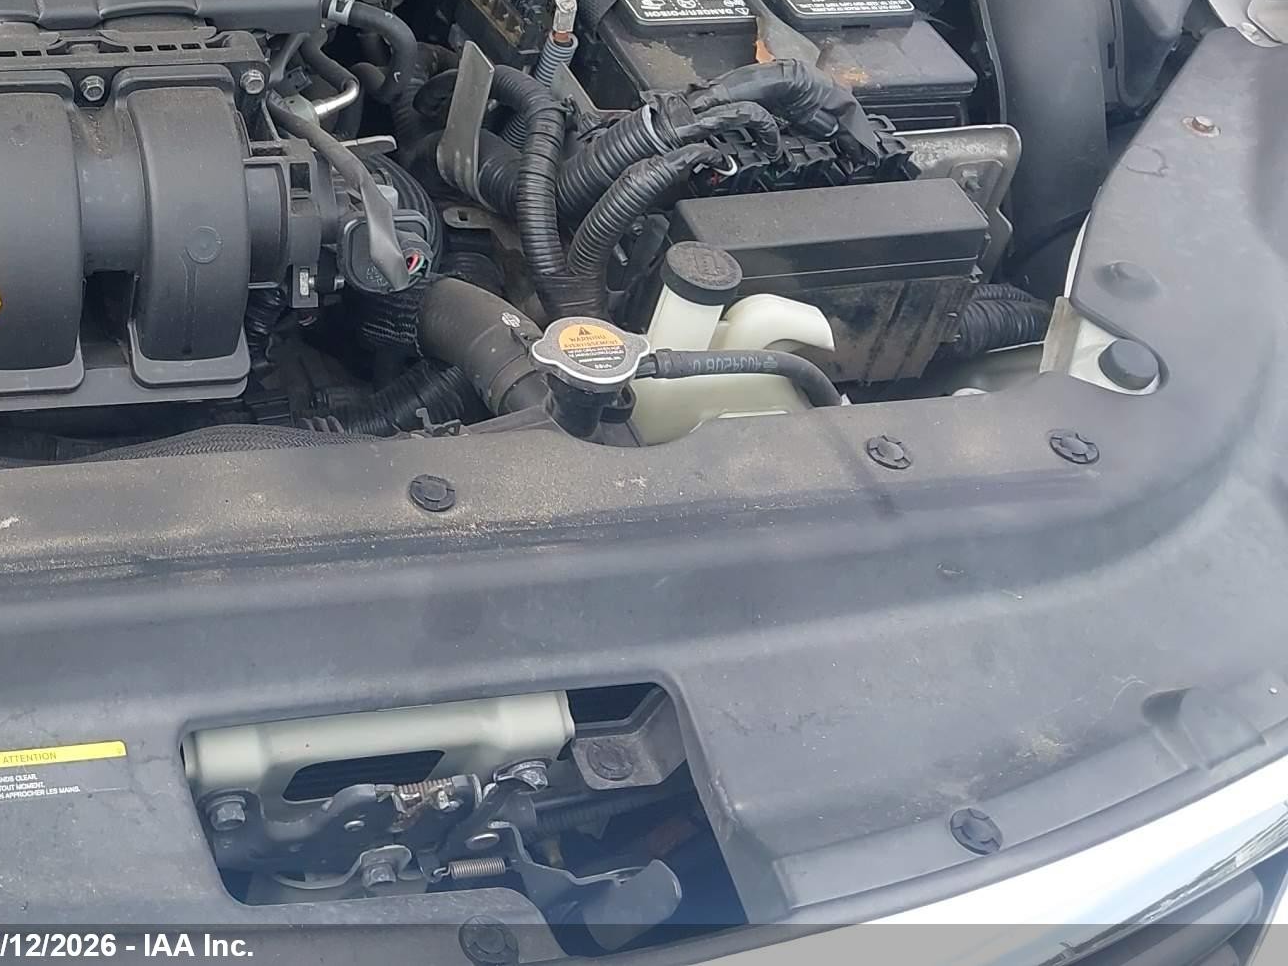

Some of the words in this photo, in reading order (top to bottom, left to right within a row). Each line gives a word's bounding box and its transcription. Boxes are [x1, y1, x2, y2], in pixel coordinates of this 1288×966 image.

[644, 8, 734, 17] DANGER/POISON
[3, 752, 57, 764] ATTENTION
[15, 781, 46, 790] MOMENT.
[5, 789, 46, 799] APPROCHER
[46, 787, 58, 795] LES
[58, 785, 81, 794] MAINS.
